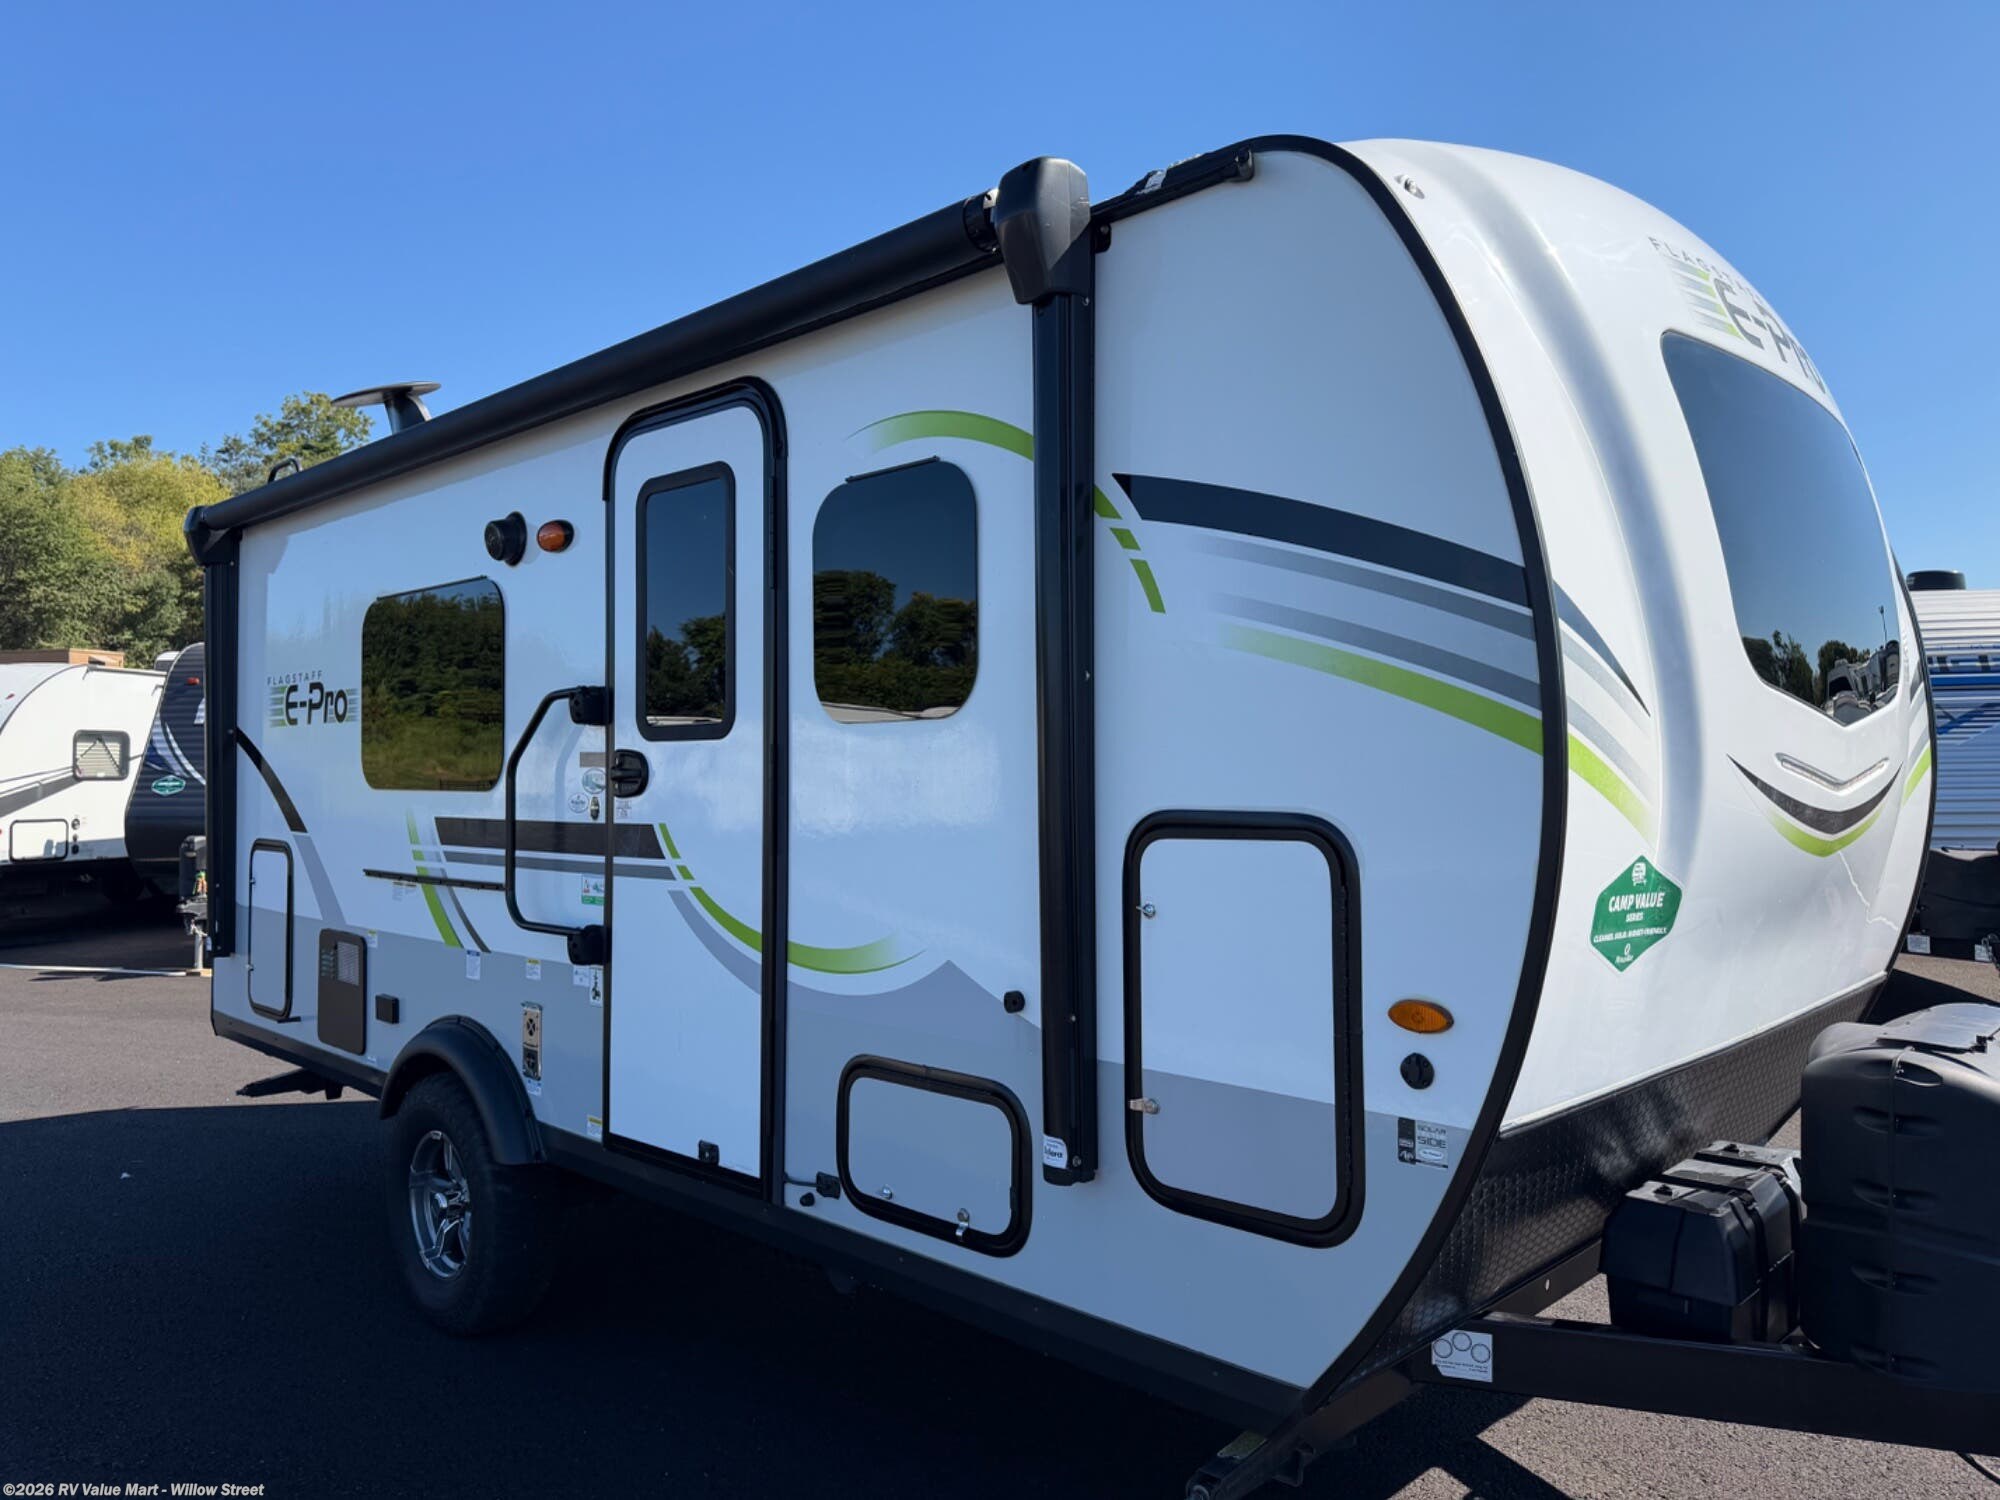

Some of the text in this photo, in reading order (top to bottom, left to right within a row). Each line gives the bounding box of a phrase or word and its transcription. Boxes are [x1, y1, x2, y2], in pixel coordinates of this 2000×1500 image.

[267, 670, 322, 686] FLAGSTAFF
[285, 681, 348, 726] E-Pro
[1608, 892, 1665, 912] CAMP VALUE
